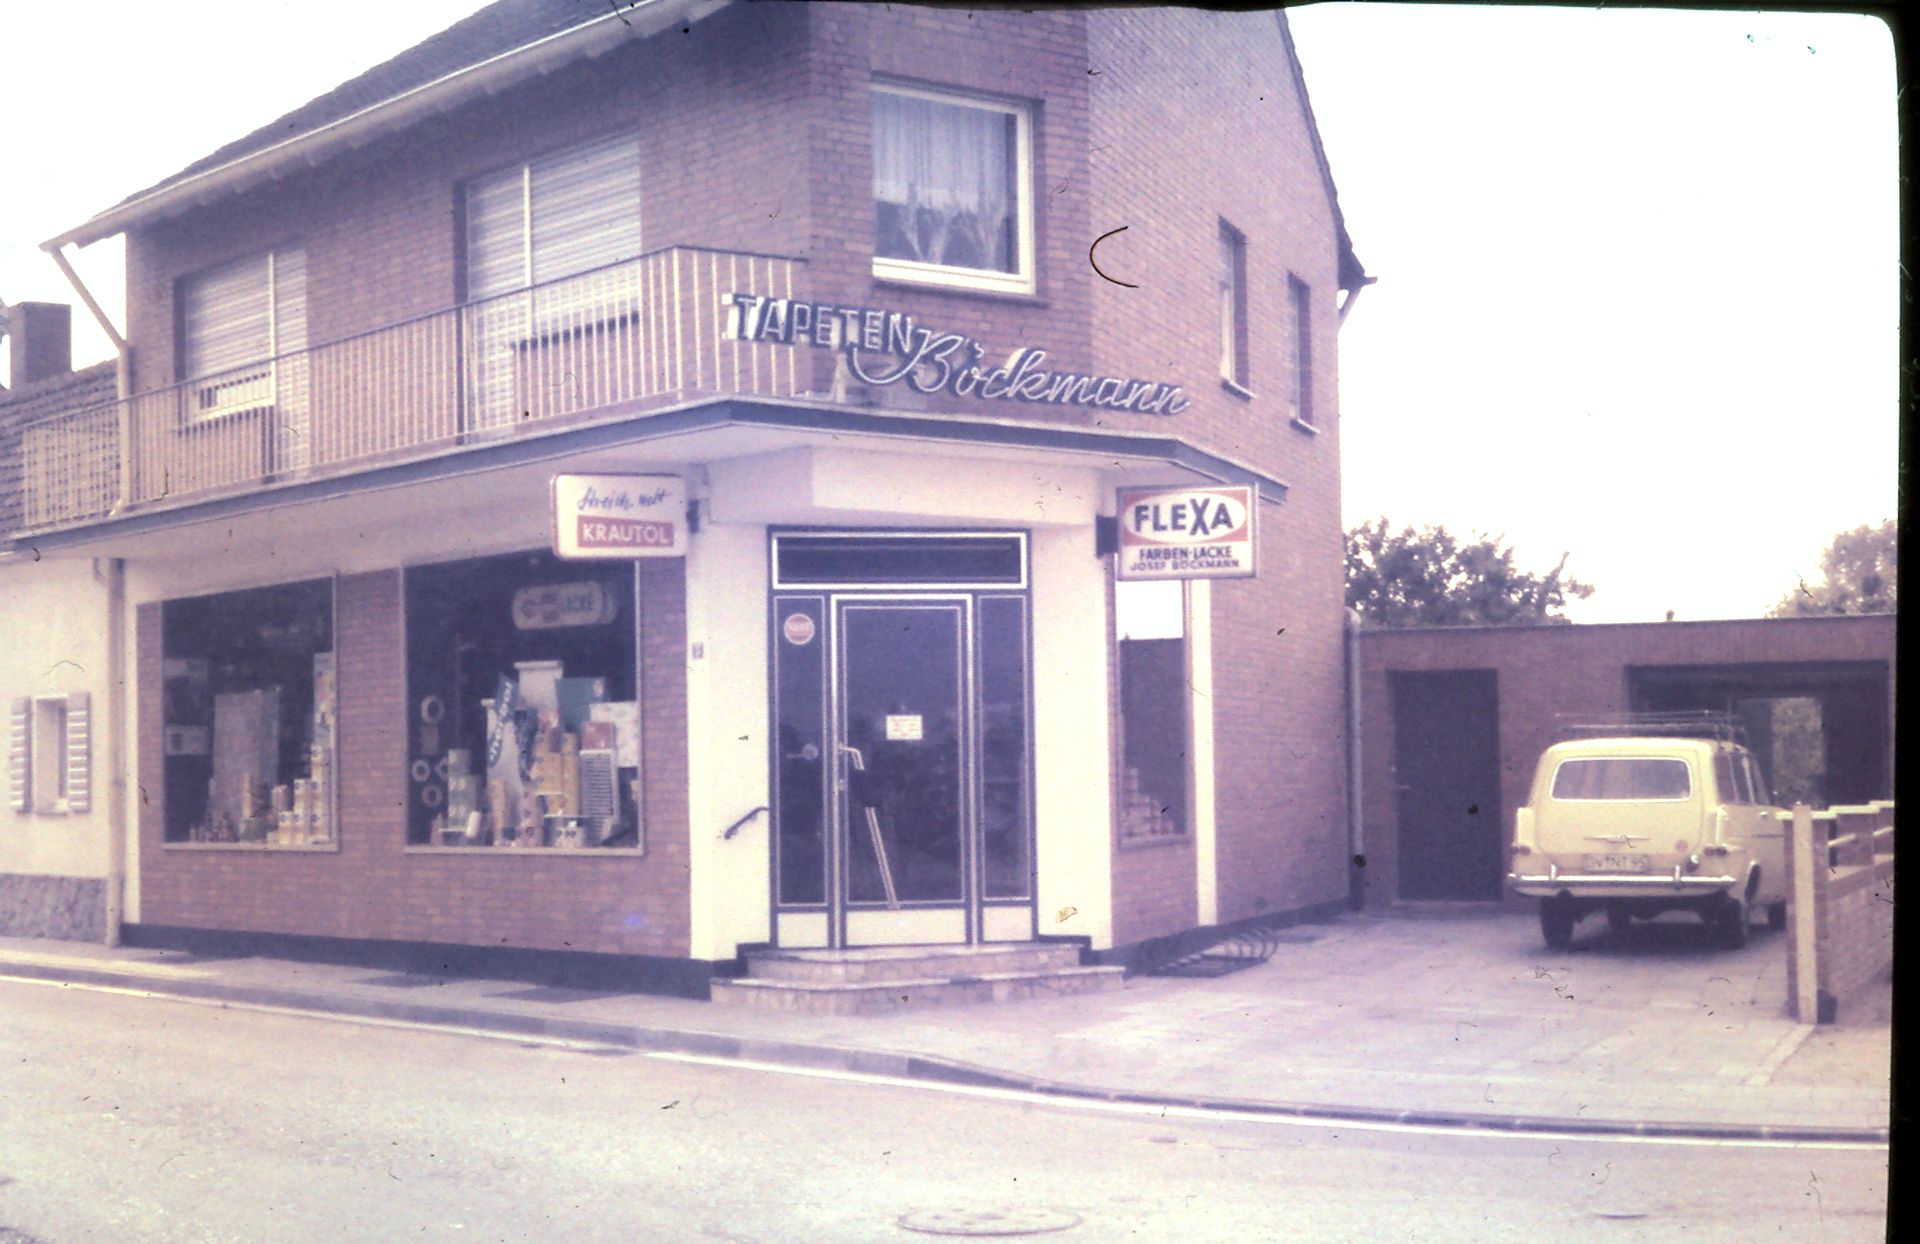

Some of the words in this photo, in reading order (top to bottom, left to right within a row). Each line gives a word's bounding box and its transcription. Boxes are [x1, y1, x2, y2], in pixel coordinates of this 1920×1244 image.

[729, 294, 913, 354] TAPETEN
[582, 523, 669, 543] KRAUTOL
[1134, 498, 1233, 535] FLEXA
